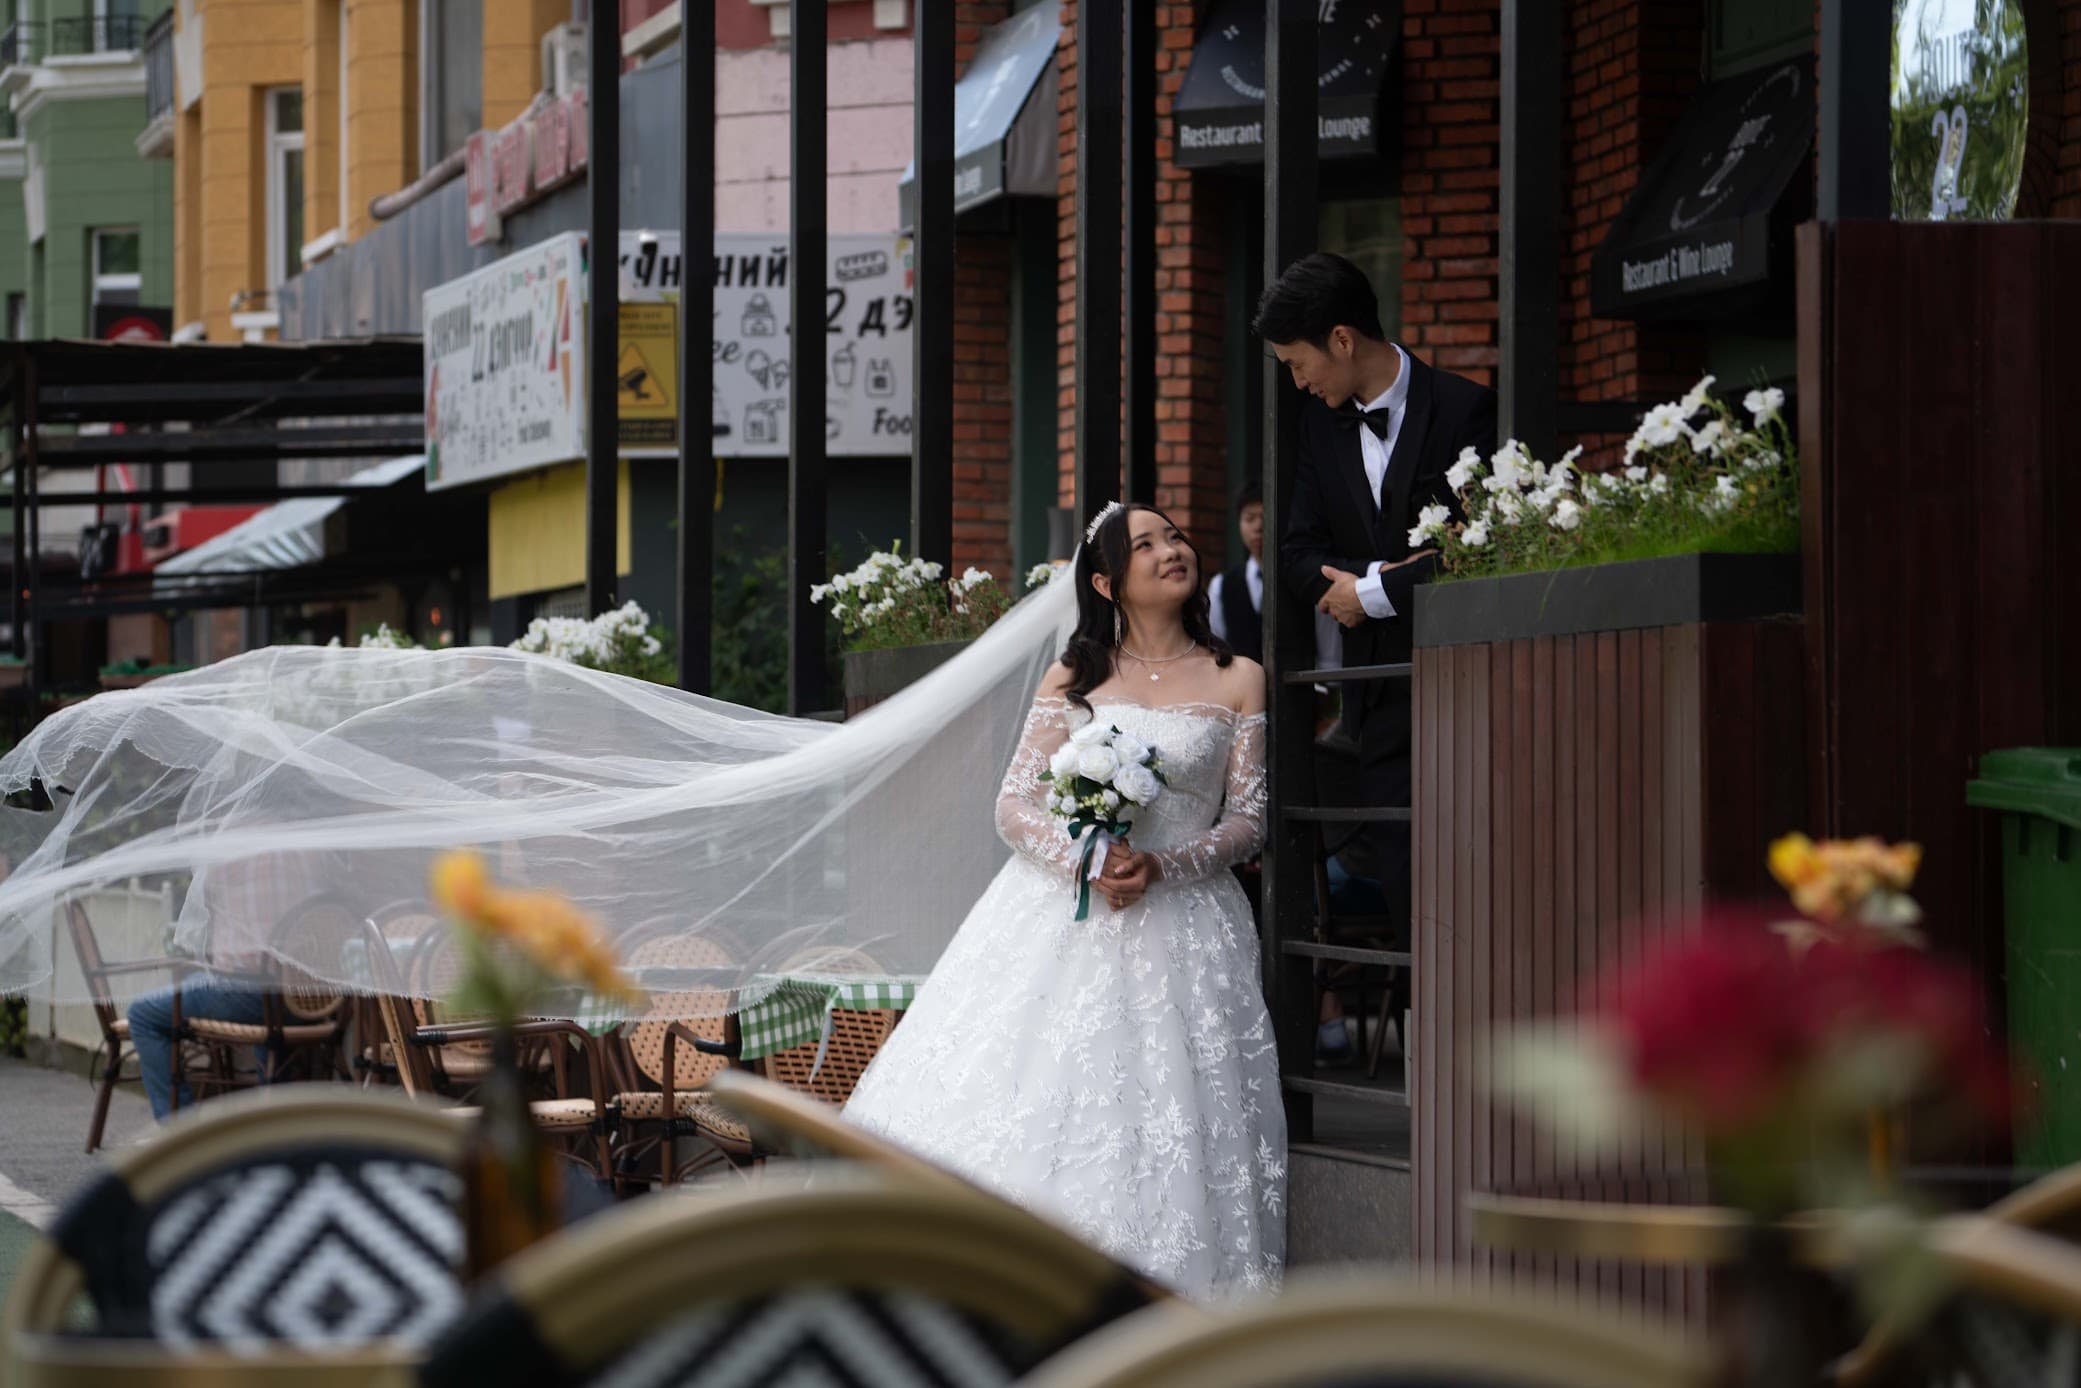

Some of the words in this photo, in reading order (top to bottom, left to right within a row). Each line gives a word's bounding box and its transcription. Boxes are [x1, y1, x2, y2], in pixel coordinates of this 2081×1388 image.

[1180, 121, 1263, 148] Restaurant
[1317, 115, 1371, 141] Lounge
[1931, 104, 1968, 217] 22
[1622, 253, 1669, 293] Restaurant
[857, 294, 914, 338] ДЭ
[872, 407, 914, 435] Foo
